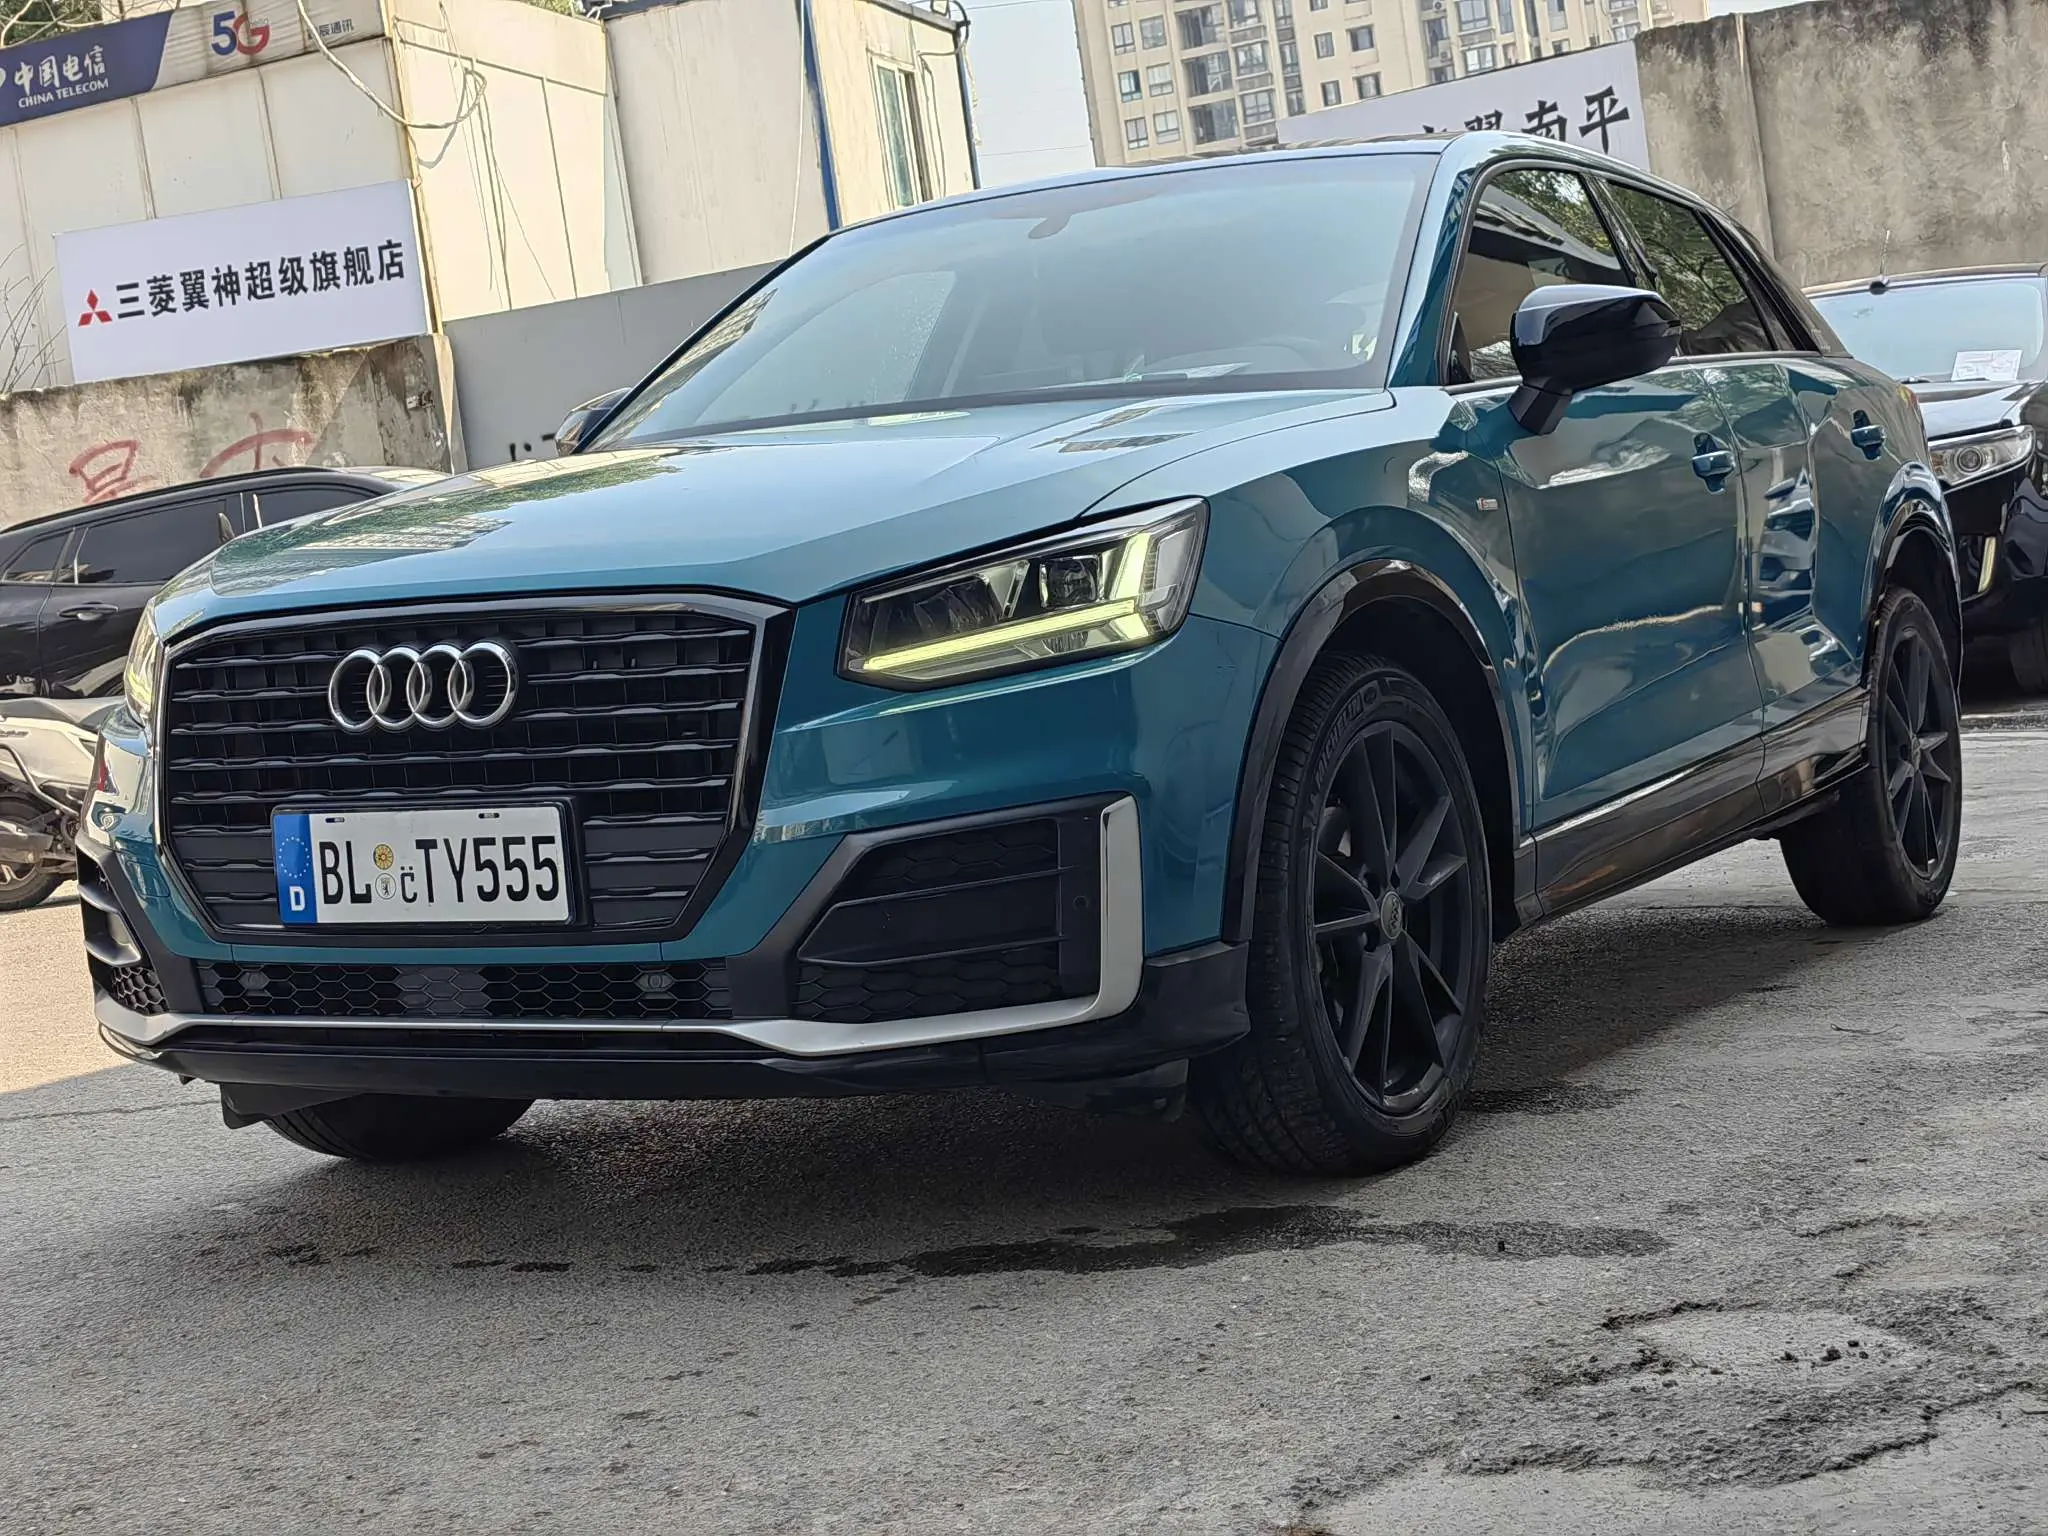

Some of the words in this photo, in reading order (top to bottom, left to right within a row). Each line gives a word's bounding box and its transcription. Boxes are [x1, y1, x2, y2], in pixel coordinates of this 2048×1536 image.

[211, 10, 270, 55] 5G
[14, 45, 106, 96] 中国电信
[18, 91, 54, 108] CHINA
[56, 78, 109, 99] TELECOM
[116, 239, 405, 319] 三菱翼神超级旗舰店
[318, 840, 372, 904] BL
[289, 886, 305, 912] D
